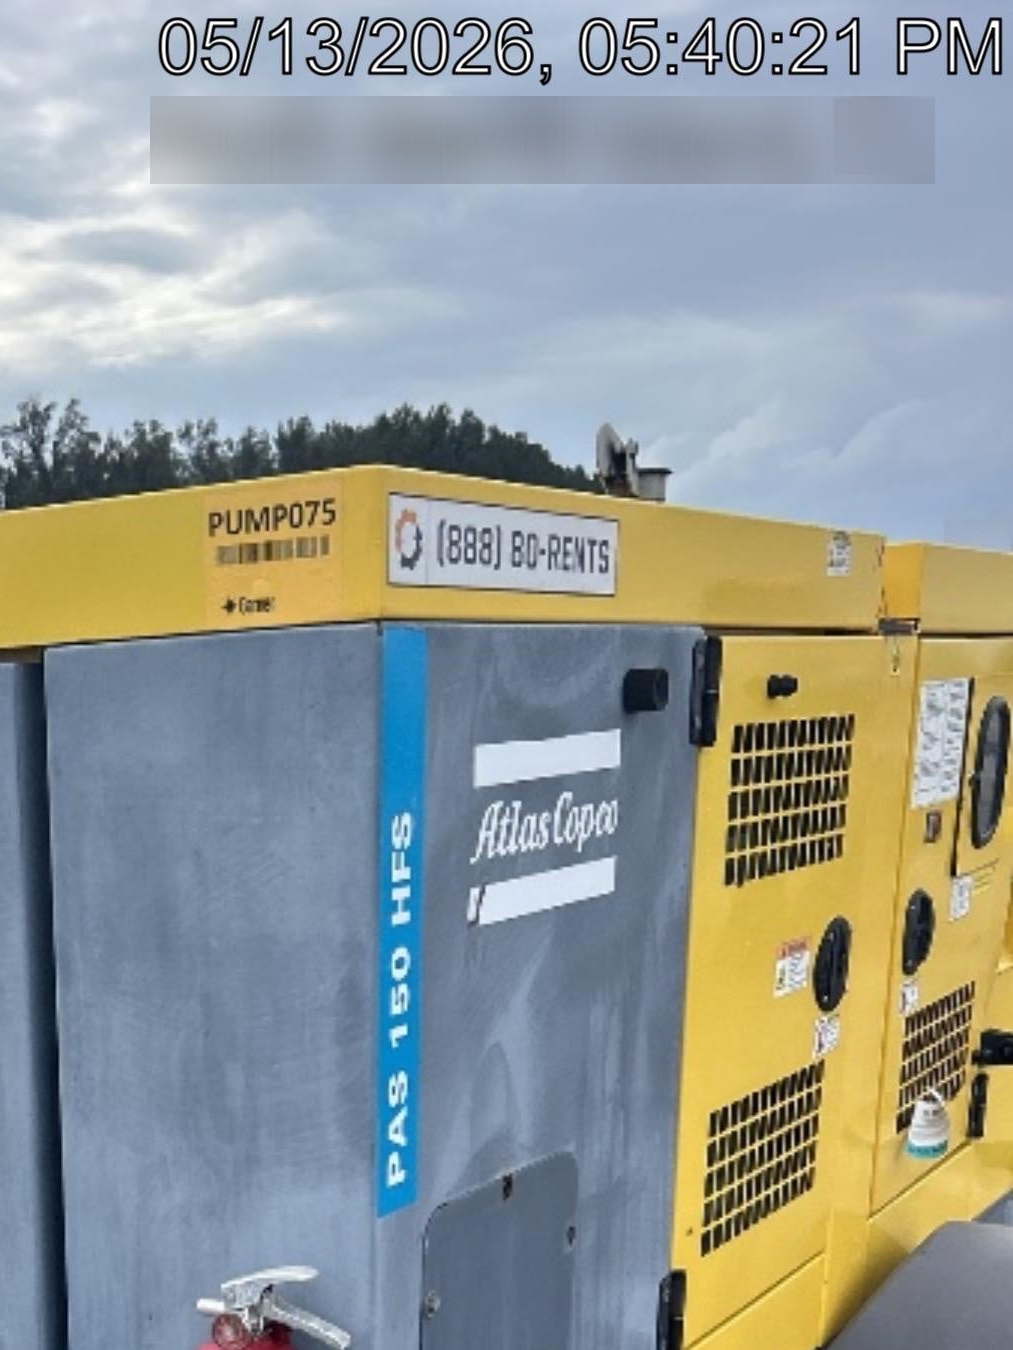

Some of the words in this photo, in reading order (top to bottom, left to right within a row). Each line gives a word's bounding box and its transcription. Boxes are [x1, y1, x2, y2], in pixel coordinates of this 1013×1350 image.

[208, 498, 338, 538] PUMP075
[437, 519, 502, 571] (888)
[390, 811, 414, 927] HFS
[469, 799, 552, 865] Atlas
[552, 791, 619, 853] Copco
[390, 945, 411, 1049] 150
[386, 1069, 409, 1188] PAS
